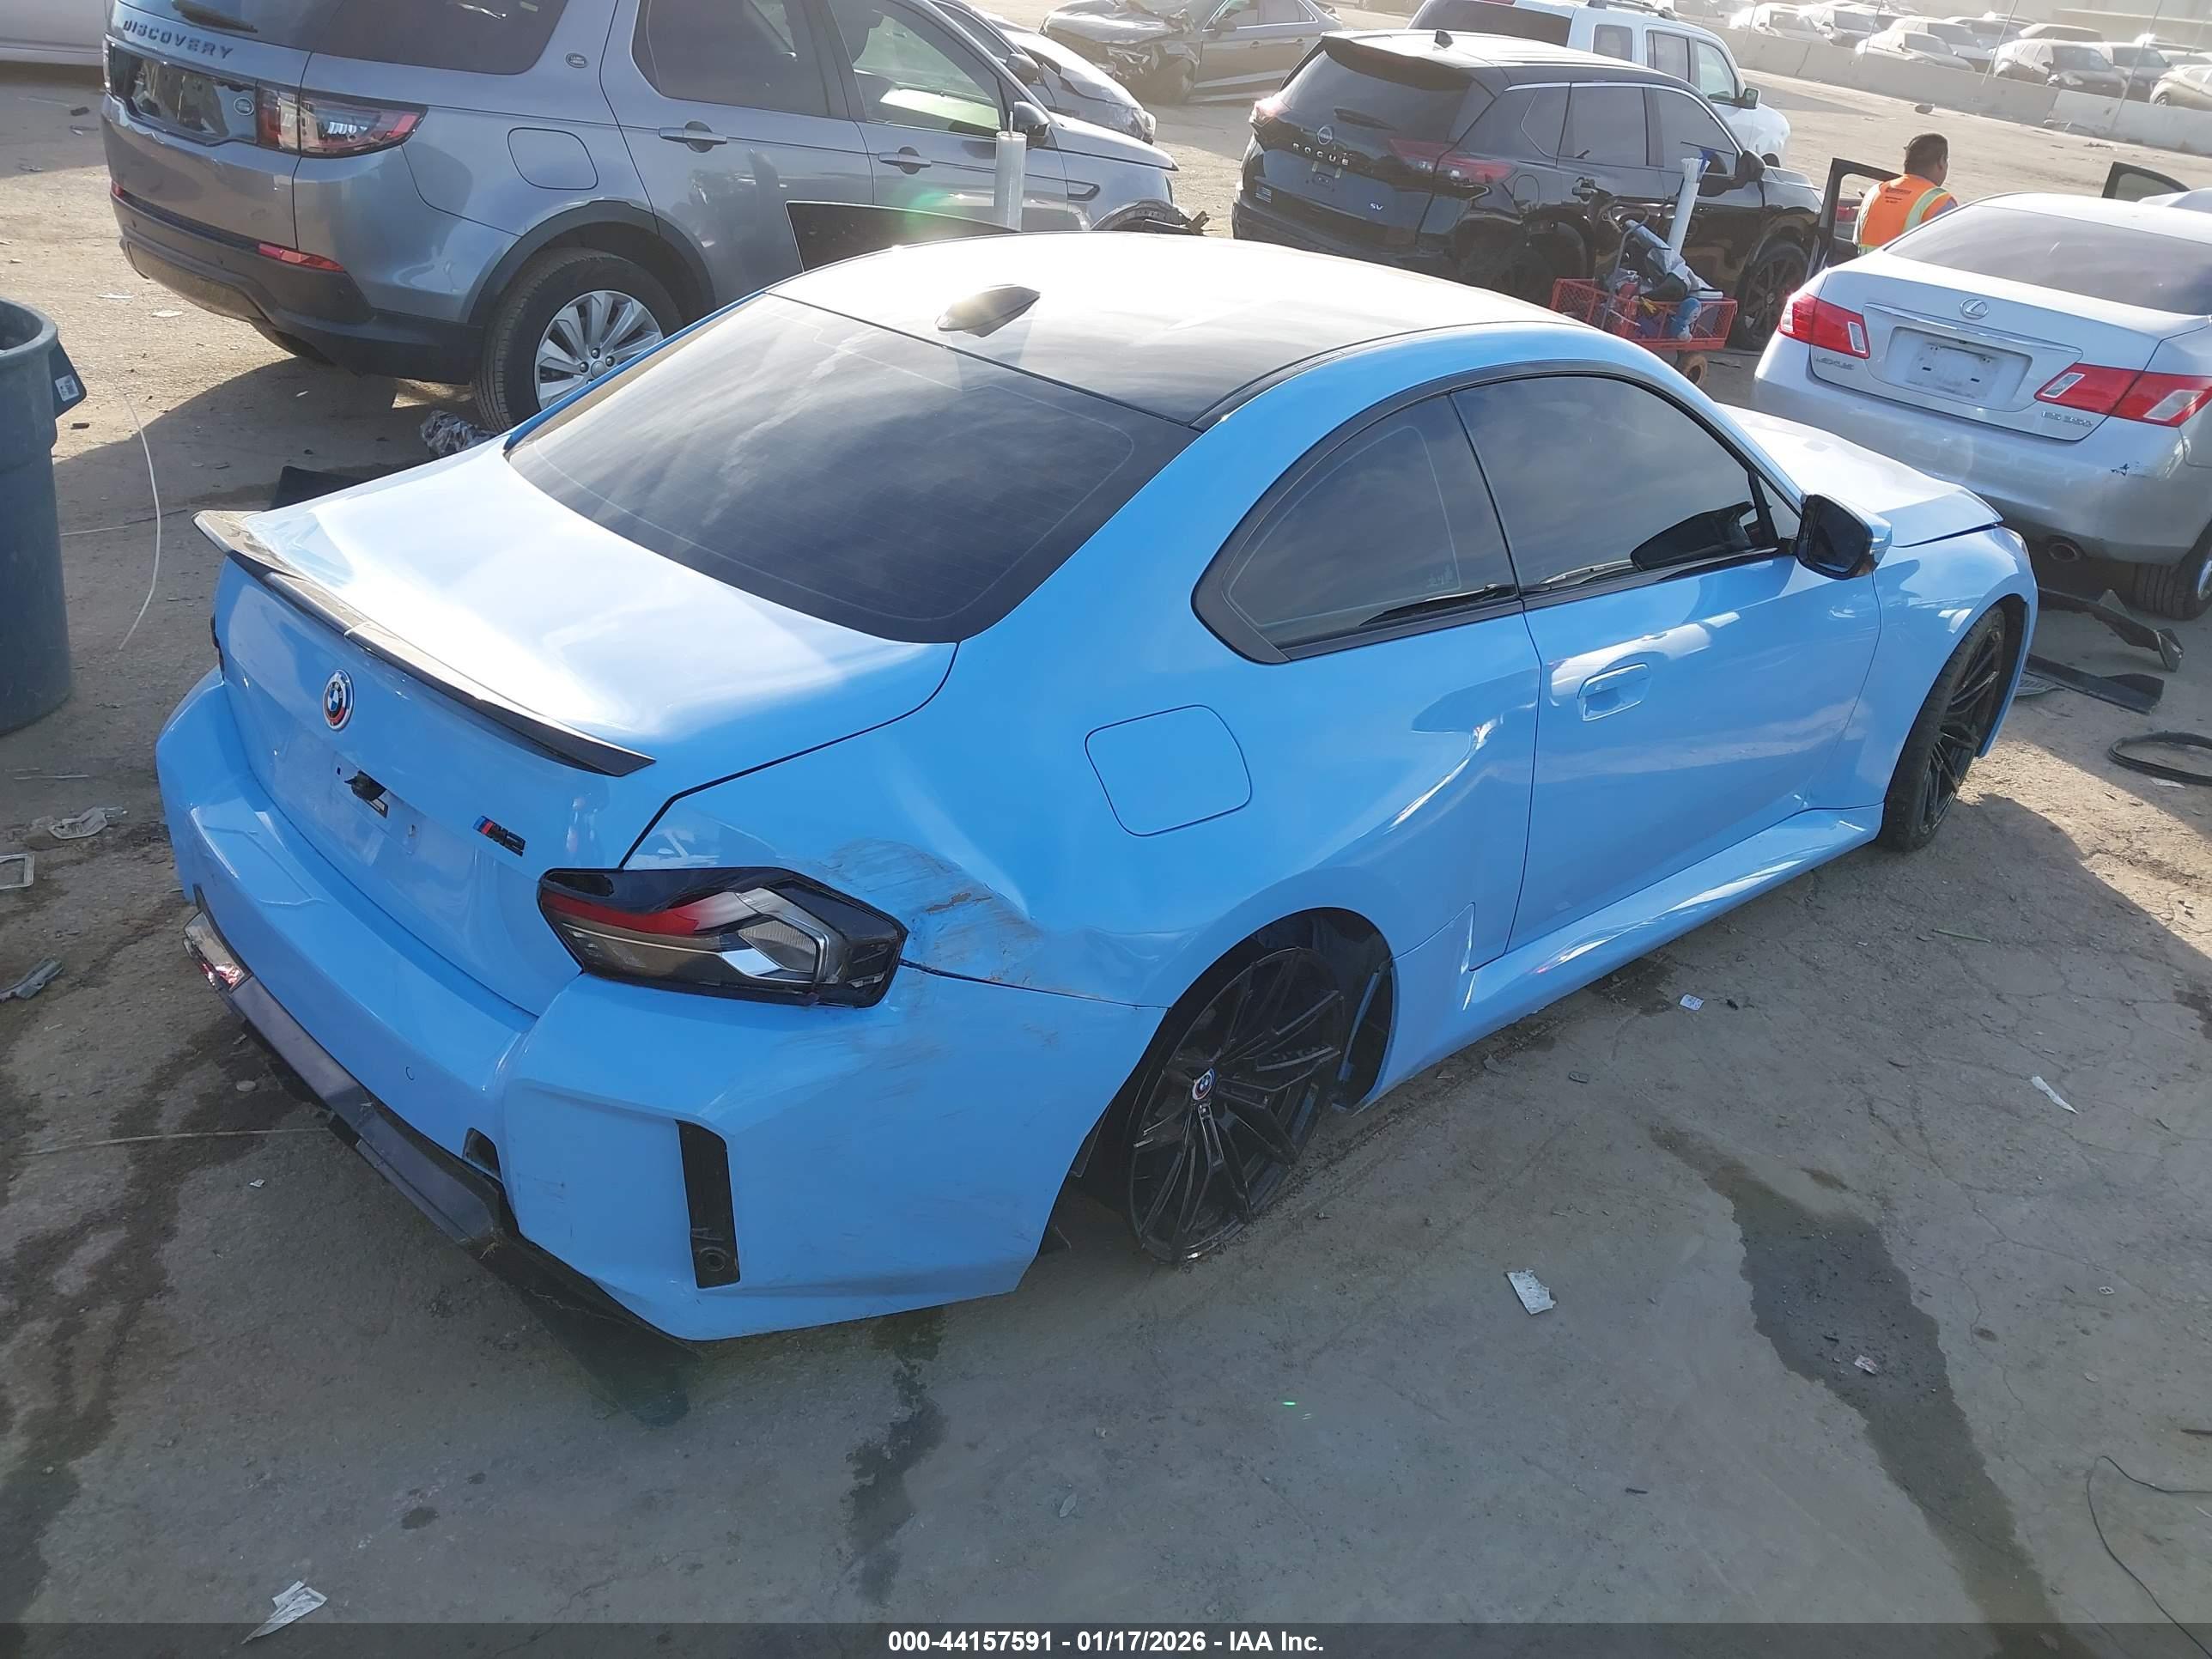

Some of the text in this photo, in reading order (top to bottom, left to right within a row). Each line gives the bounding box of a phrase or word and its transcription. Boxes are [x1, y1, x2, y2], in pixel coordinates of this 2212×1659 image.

[123, 19, 234, 59] DISCOVERY
[1292, 142, 1349, 166] ROGUE
[1370, 202, 1384, 211] SV
